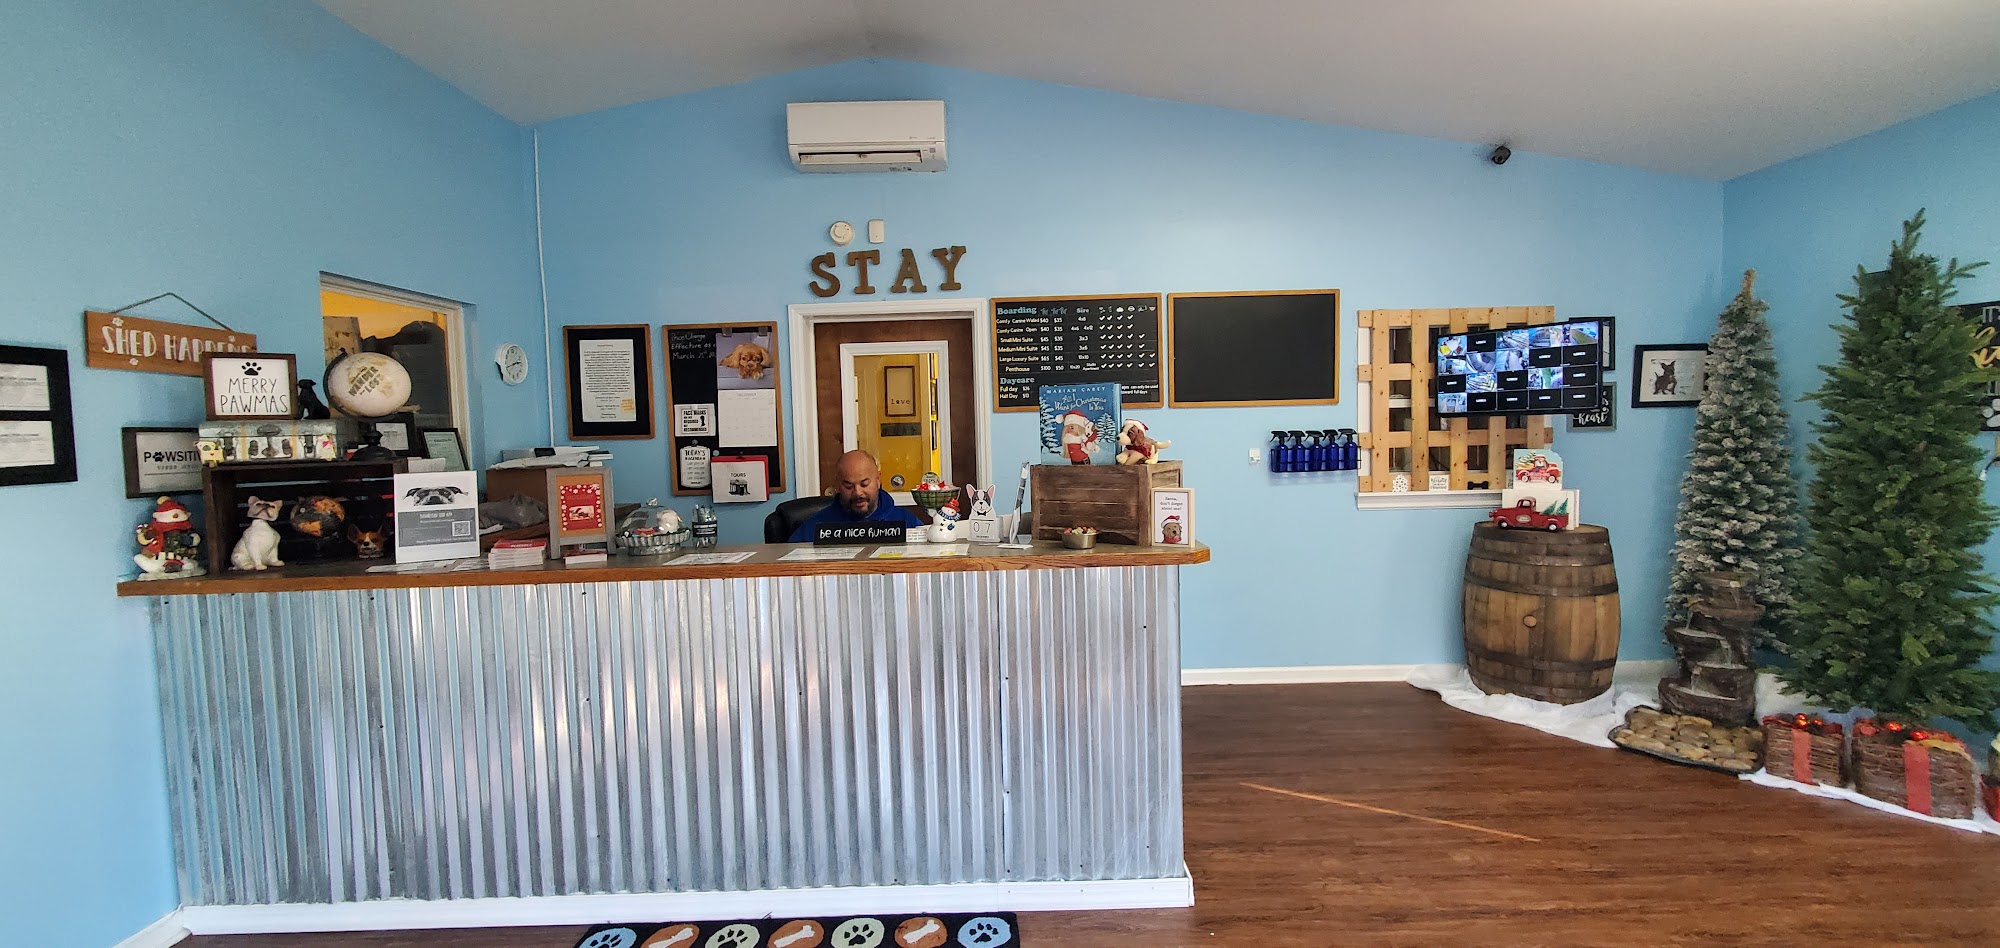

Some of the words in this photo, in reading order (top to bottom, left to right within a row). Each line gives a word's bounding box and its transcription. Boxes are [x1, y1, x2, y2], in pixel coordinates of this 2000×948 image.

[809, 246, 966, 297] STAY
[997, 306, 1037, 314] Boarding
[102, 325, 156, 357] SHED
[672, 352, 695, 360] March
[228, 378, 277, 394] MERRY
[221, 394, 289, 414] PAWMAS
[1076, 396, 1106, 407] Christmas
[1093, 402, 1105, 410] You
[820, 529, 831, 538] be
[833, 529, 841, 538] a
[844, 528, 866, 538] nice
